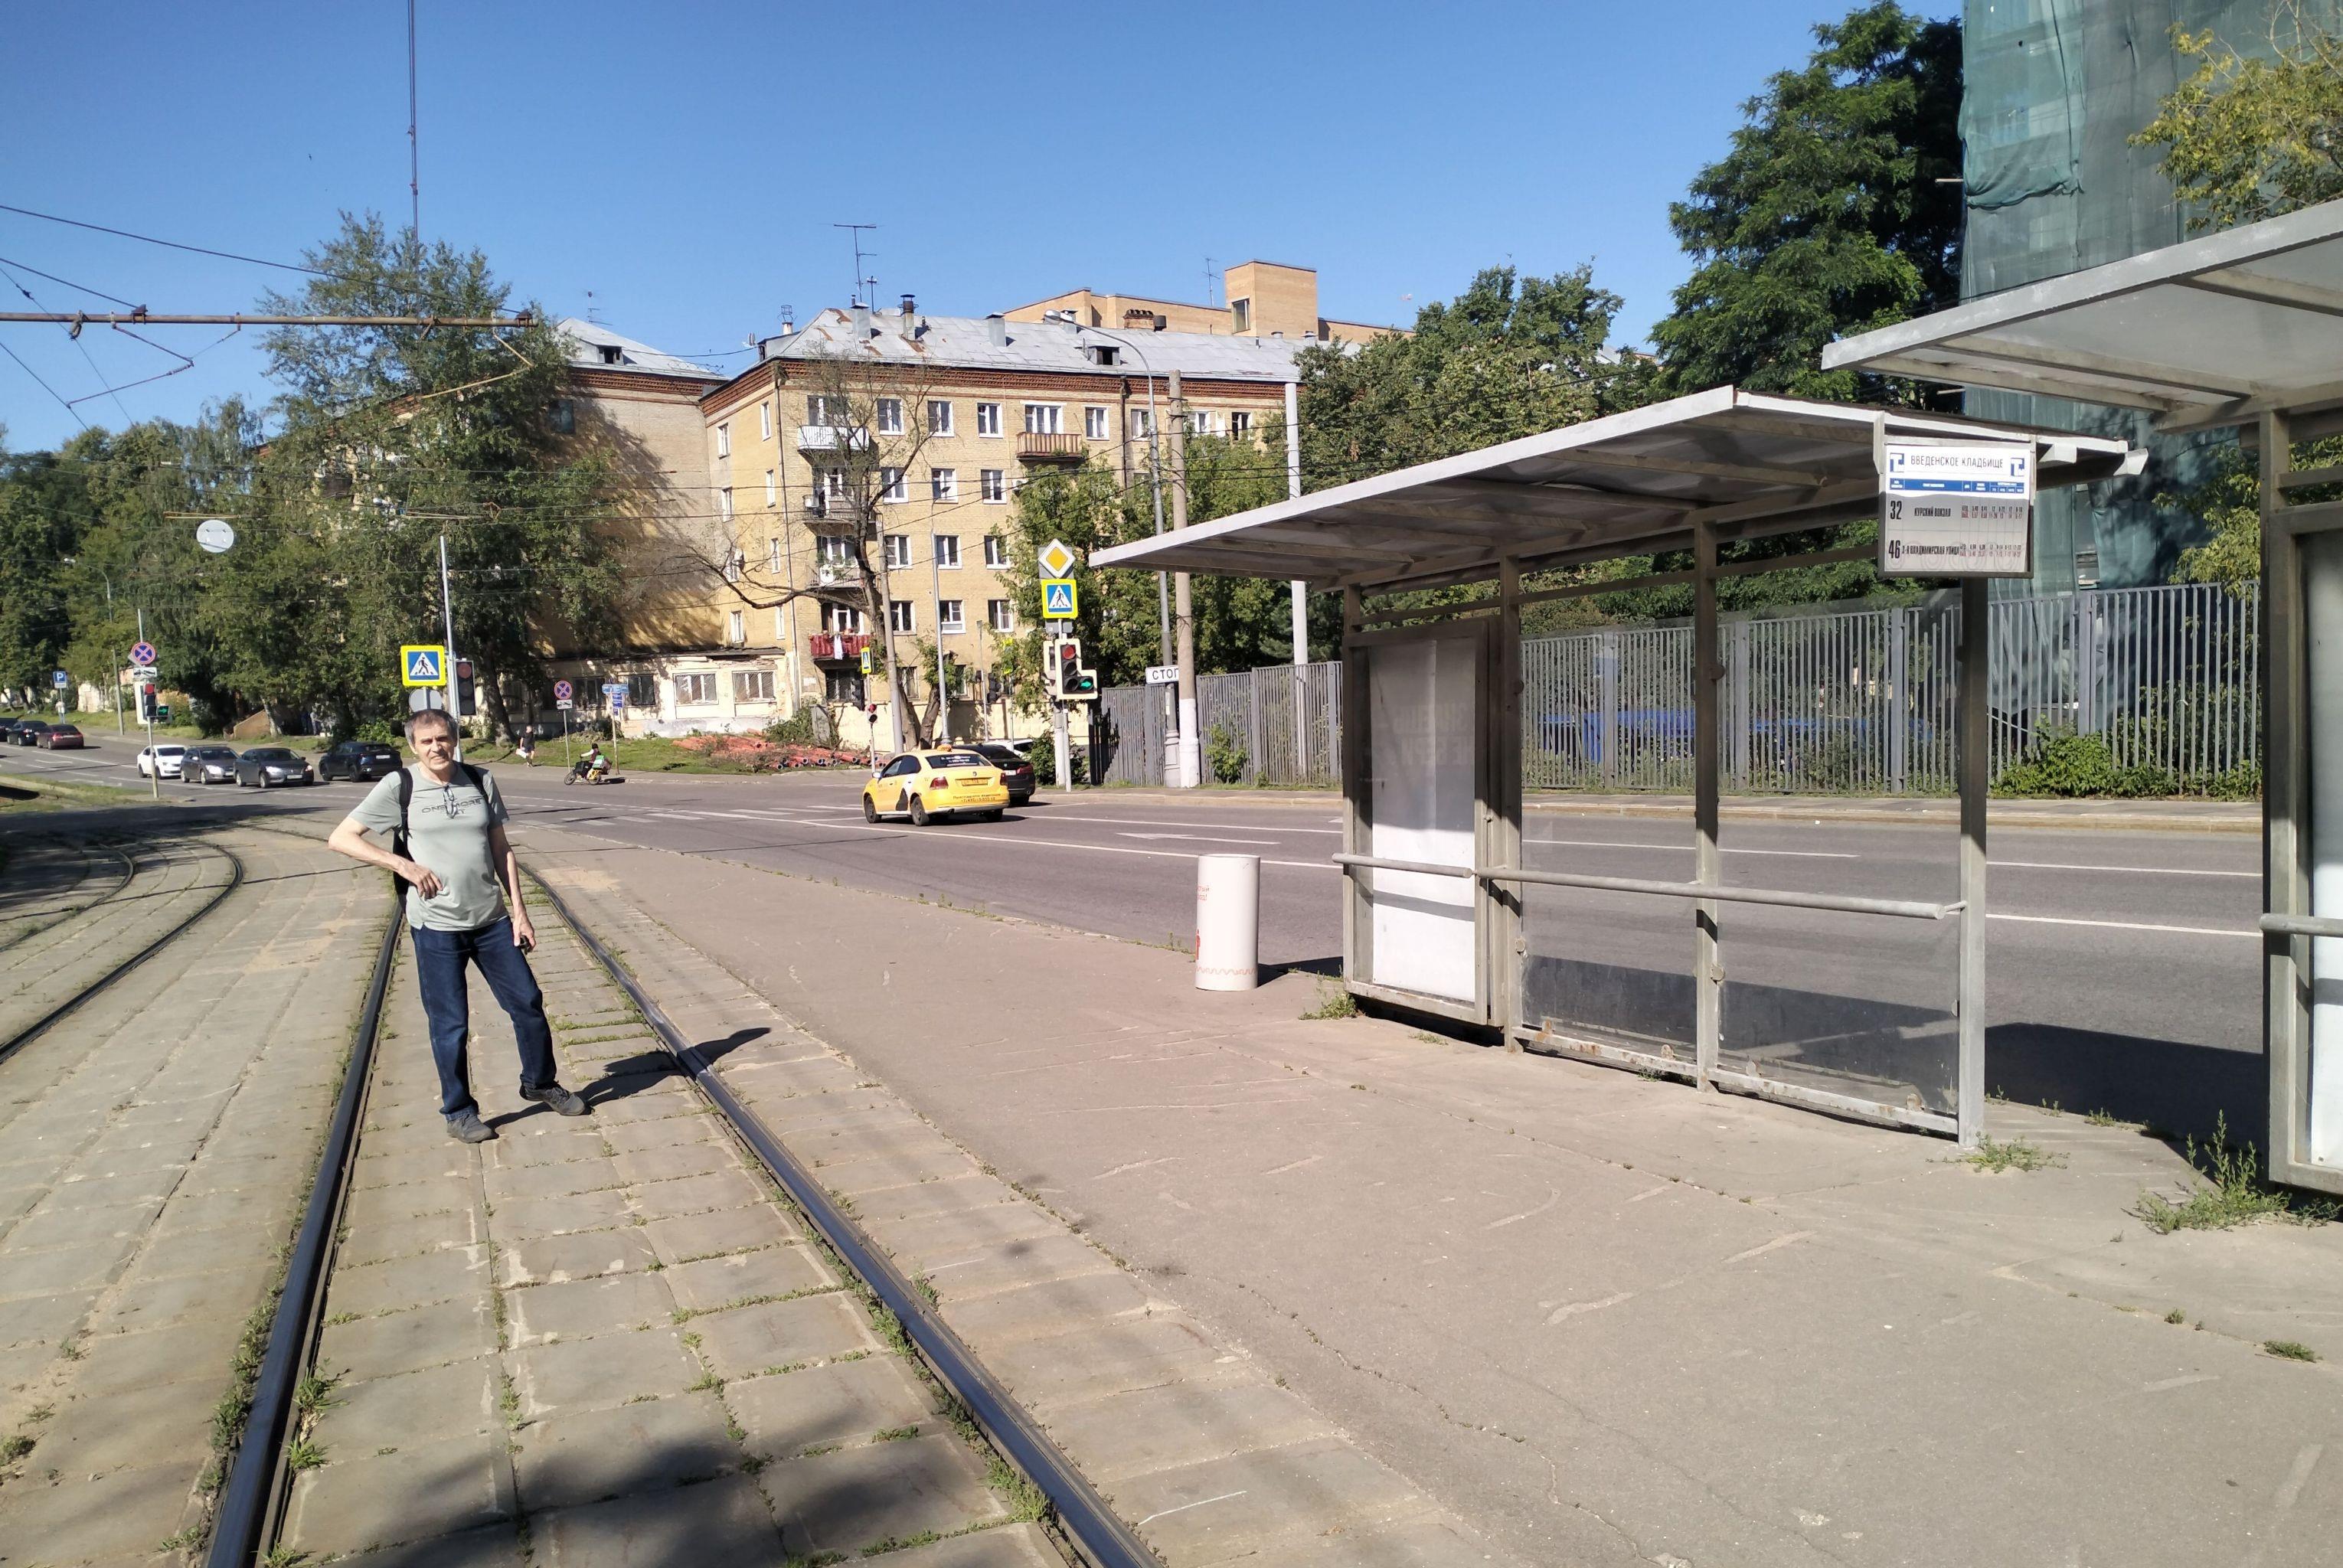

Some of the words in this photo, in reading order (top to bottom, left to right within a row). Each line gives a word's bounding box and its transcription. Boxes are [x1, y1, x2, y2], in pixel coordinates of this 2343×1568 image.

[1910, 455, 1959, 466] ВВЕДЕНСКОЕ
[1962, 457, 2003, 469] КЛАДБИЩЕ
[1890, 500, 1902, 520] 32
[1888, 540, 1900, 559] 46
[57, 673, 64, 681] P
